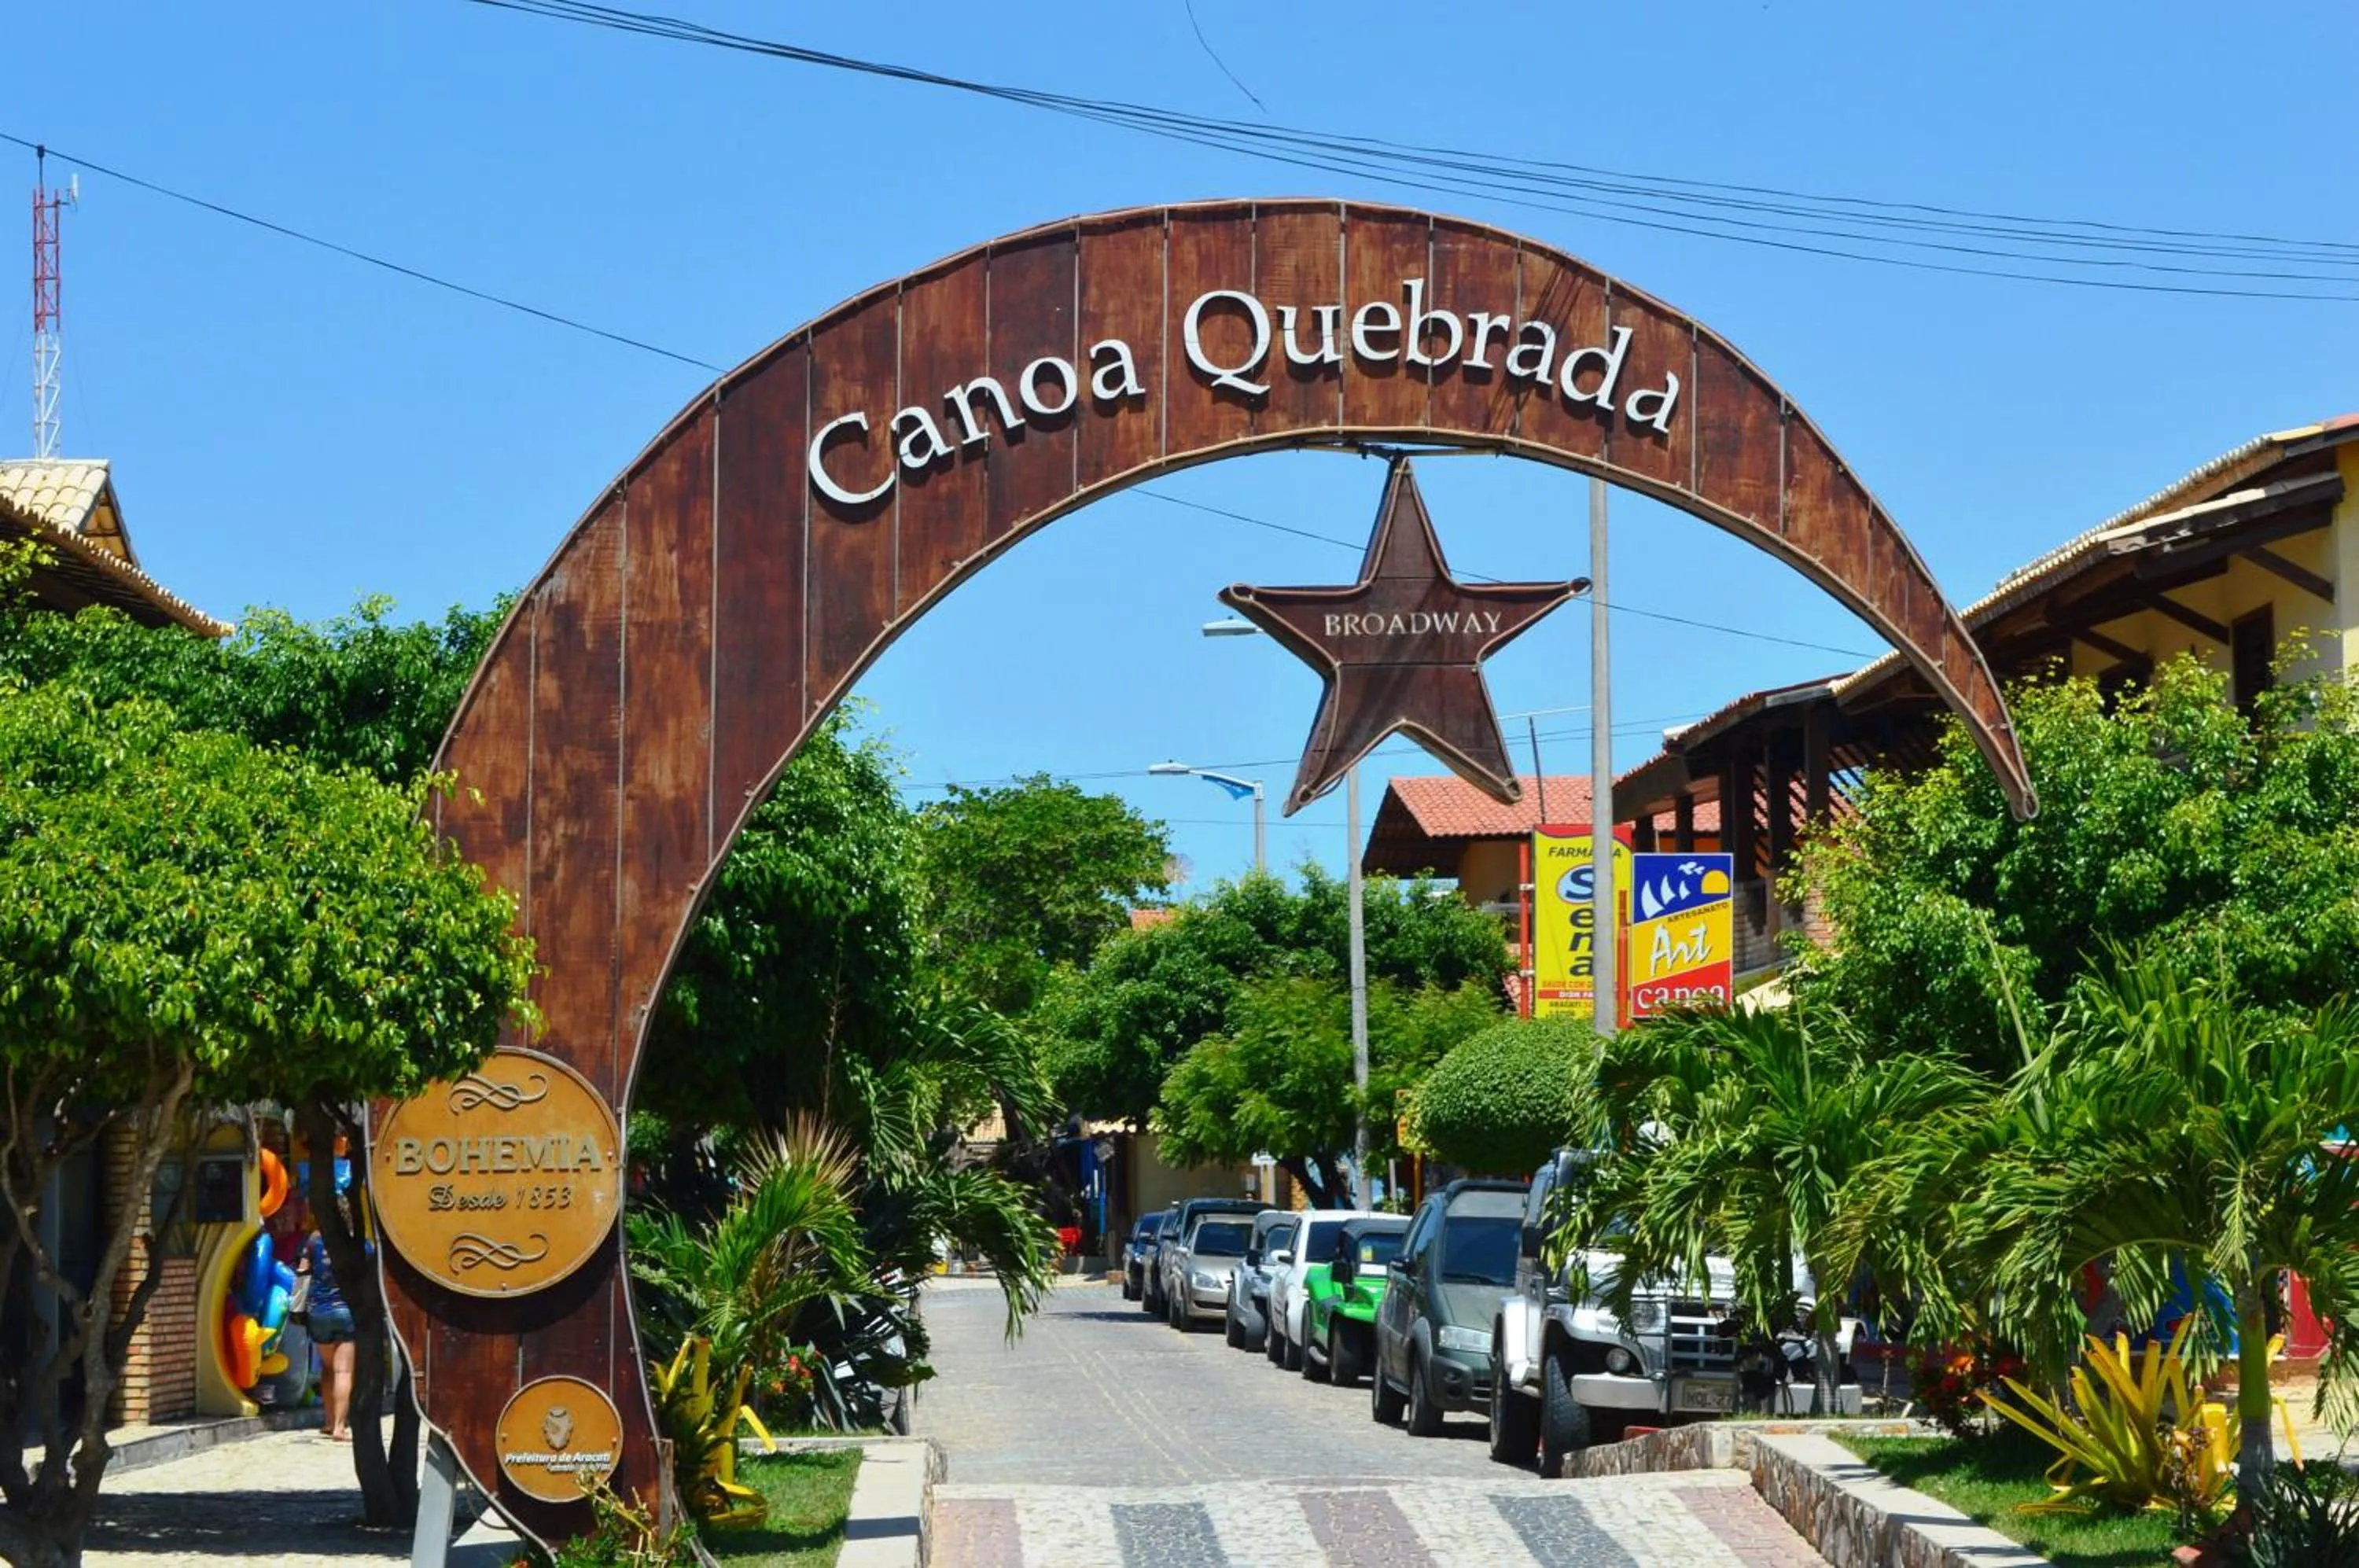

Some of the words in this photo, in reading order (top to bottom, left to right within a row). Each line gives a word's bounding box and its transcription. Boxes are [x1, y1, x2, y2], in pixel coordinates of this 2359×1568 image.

[808, 339, 1146, 504] Canoa
[1183, 278, 1680, 433] Quebrada
[1324, 611, 1503, 636] BROADWAY
[1668, 902, 1728, 923] ARTESANATO
[1651, 922, 1713, 977] Art
[395, 1135, 603, 1176] BOHEMIA
[427, 1183, 508, 1212] Desde
[515, 1183, 572, 1209] 1853
[506, 1452, 557, 1464] Prefeitura
[558, 1452, 572, 1463] de
[572, 1452, 610, 1463] Aracati
